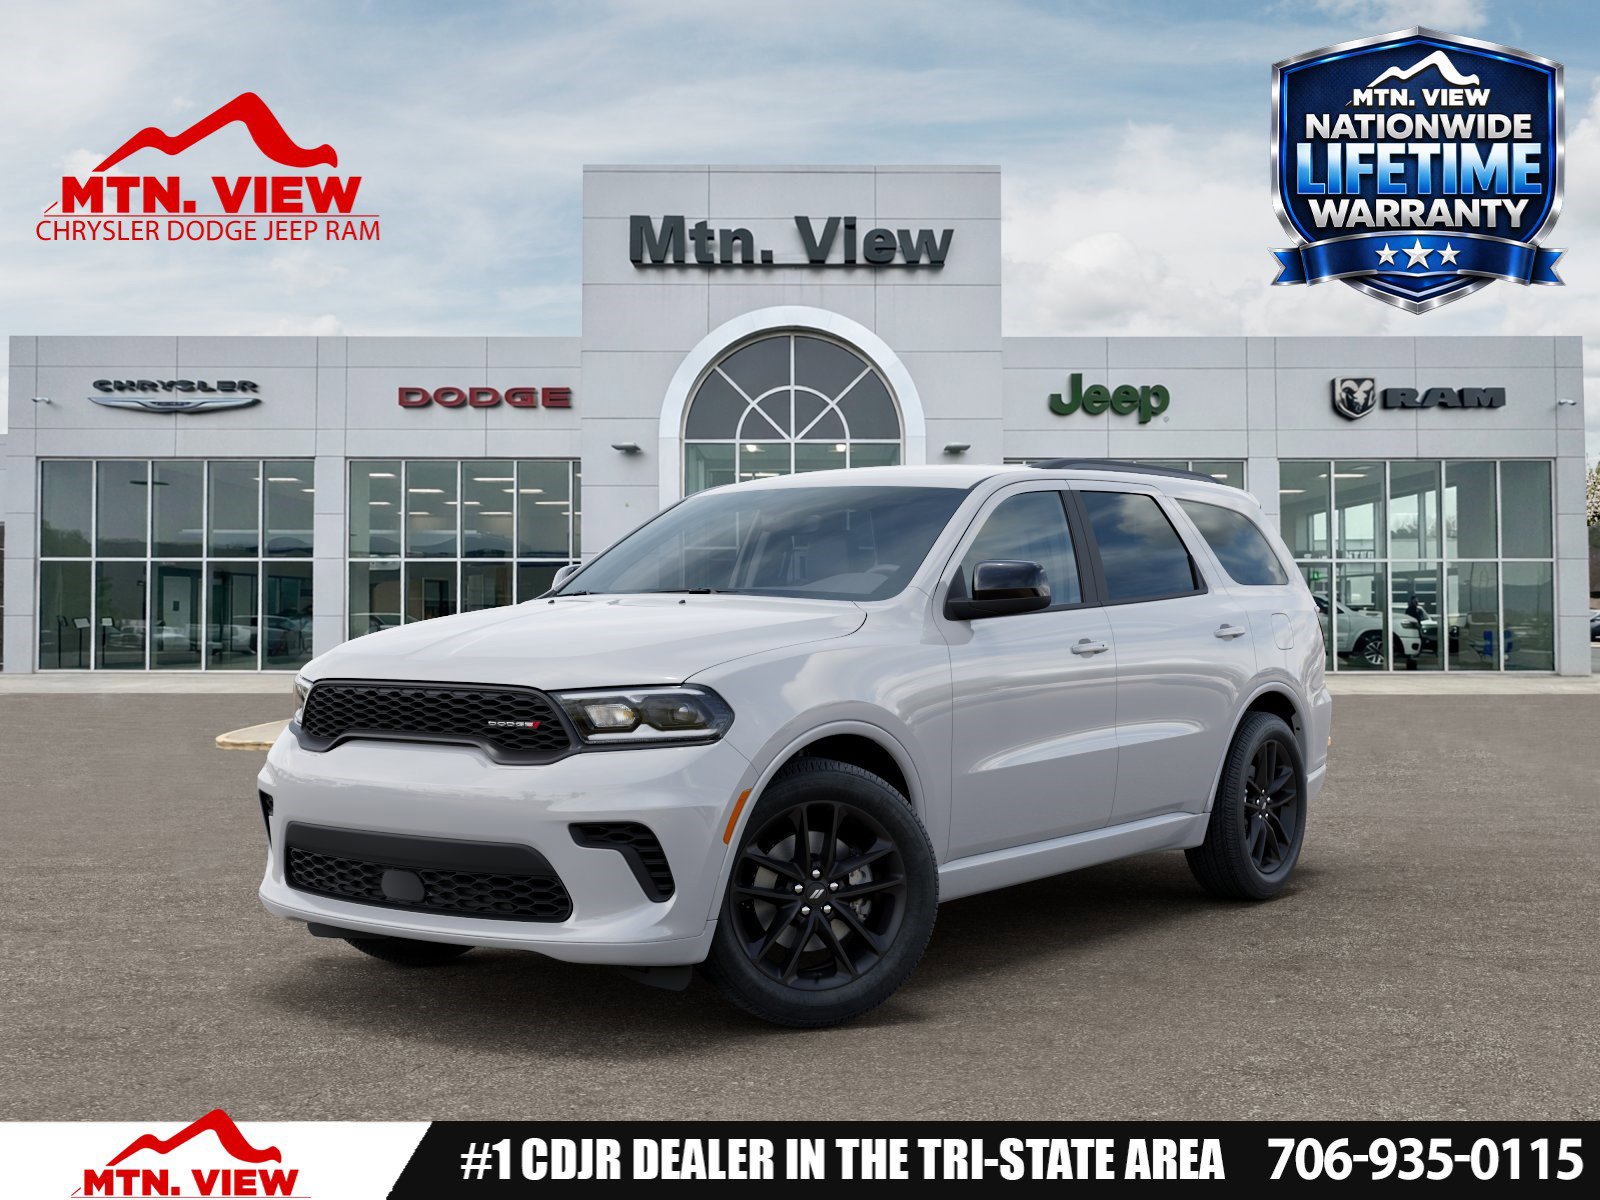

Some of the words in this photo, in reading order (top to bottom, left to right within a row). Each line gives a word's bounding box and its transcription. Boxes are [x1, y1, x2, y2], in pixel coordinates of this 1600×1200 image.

[629, 214, 774, 265] Mtn.
[794, 215, 955, 265] View
[93, 379, 260, 393] CHRYSLER
[398, 387, 571, 408] DODGE
[1048, 372, 1170, 424] Jeep
[1380, 387, 1506, 410] RAM
[487, 720, 534, 728] DODGE
